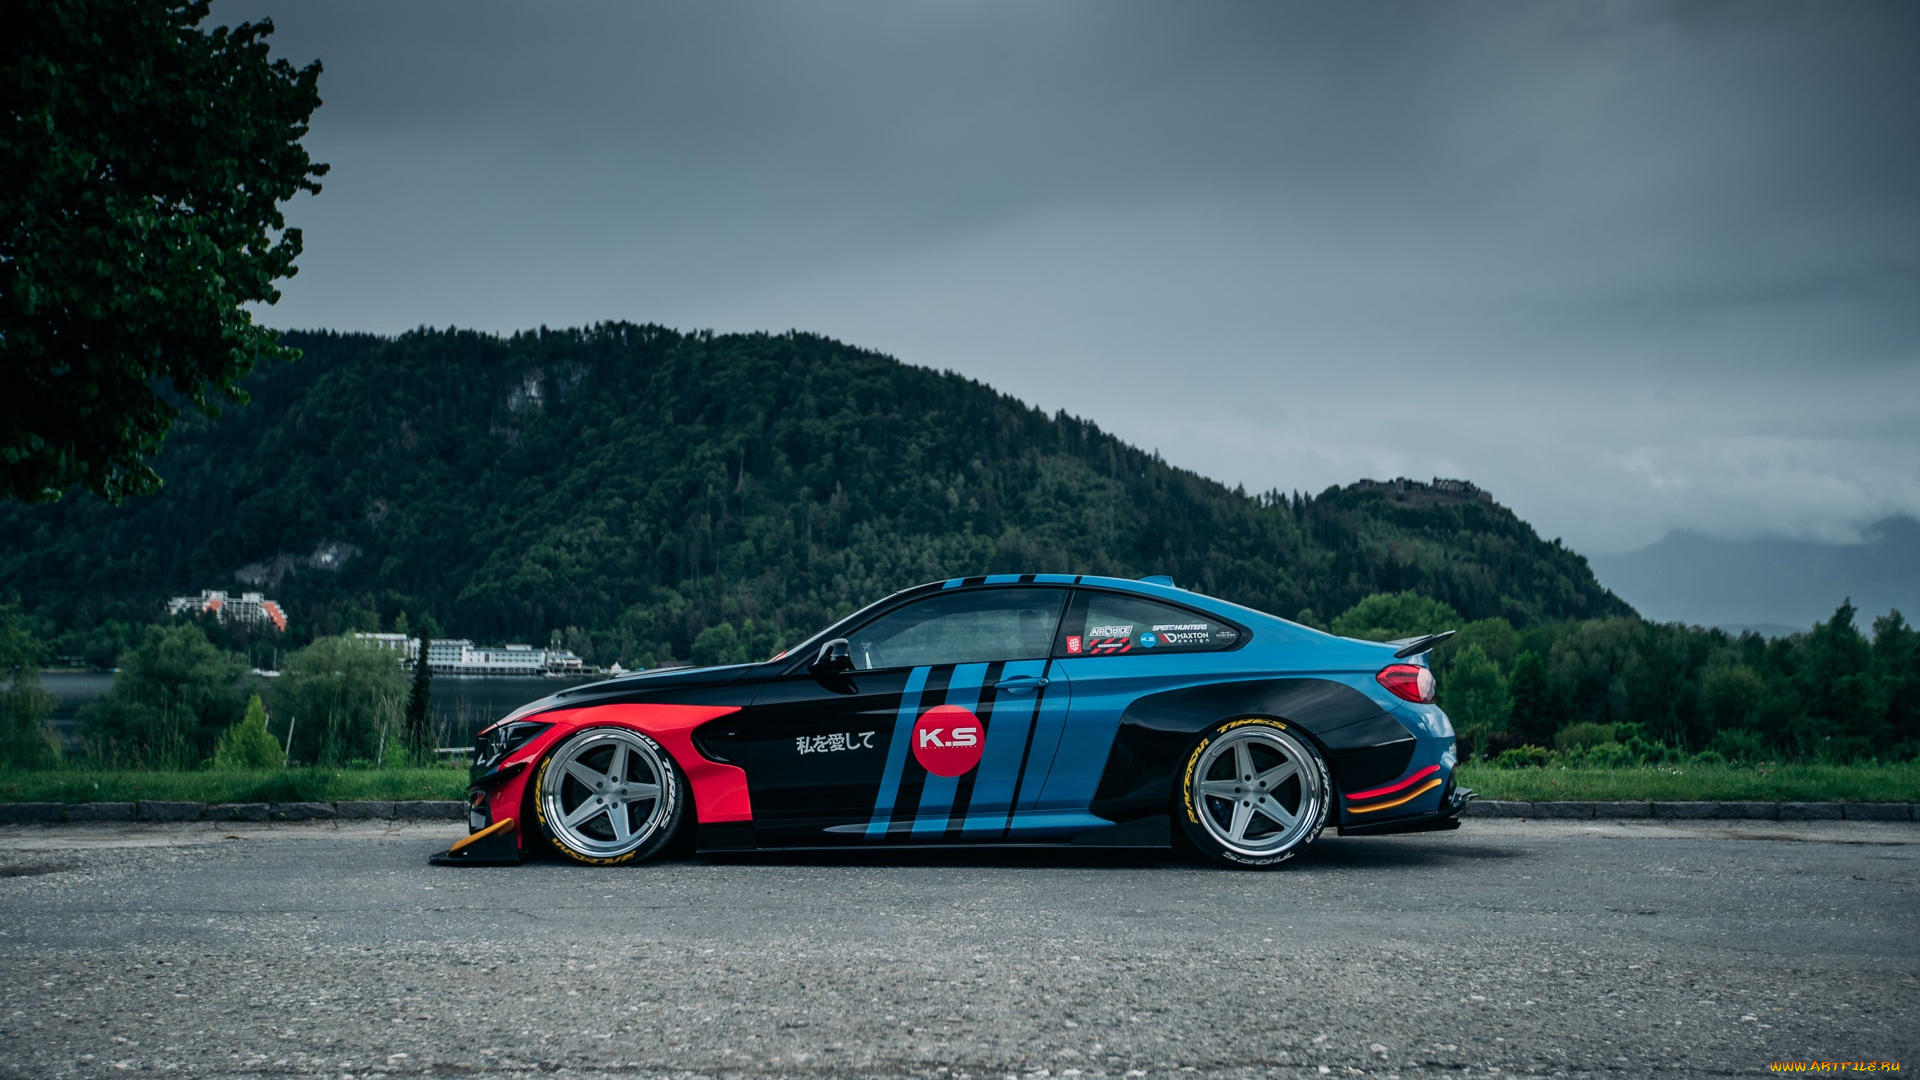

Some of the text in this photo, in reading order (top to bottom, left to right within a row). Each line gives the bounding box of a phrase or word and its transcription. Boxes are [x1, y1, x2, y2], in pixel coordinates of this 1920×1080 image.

[1152, 624, 1208, 632] SPEEDHUNTERS
[1216, 718, 1288, 734] TIRES
[796, 731, 876, 755] 私を愛して
[919, 727, 977, 748] K.S
[534, 756, 551, 827] TIRES
[660, 757, 677, 830] TIRES
